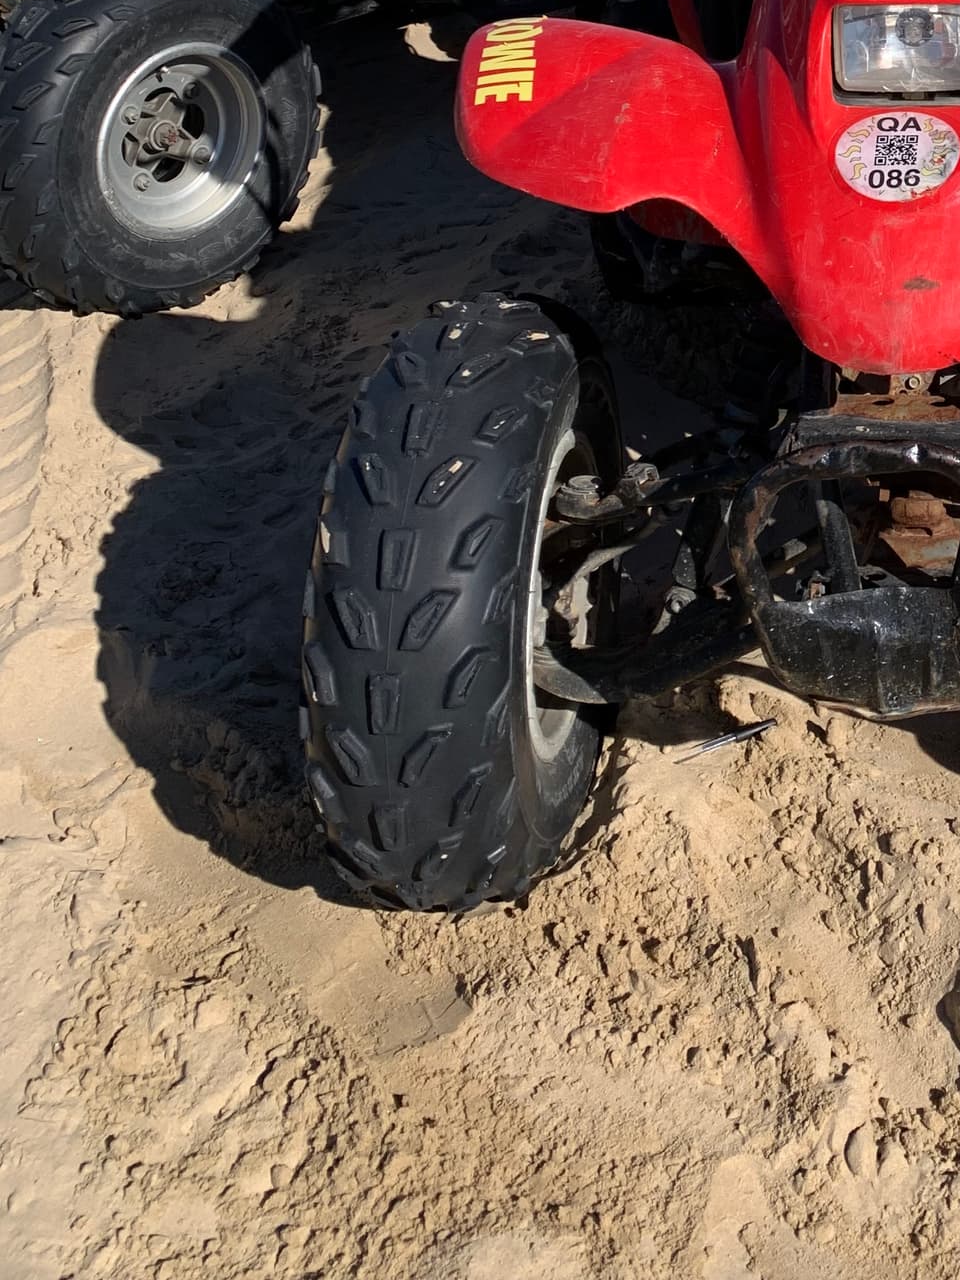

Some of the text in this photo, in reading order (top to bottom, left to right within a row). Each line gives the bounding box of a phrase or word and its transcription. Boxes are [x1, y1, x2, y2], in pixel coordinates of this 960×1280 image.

[474, 16, 545, 106] OWIE
[876, 116, 922, 132] QA
[868, 169, 921, 189] 086
